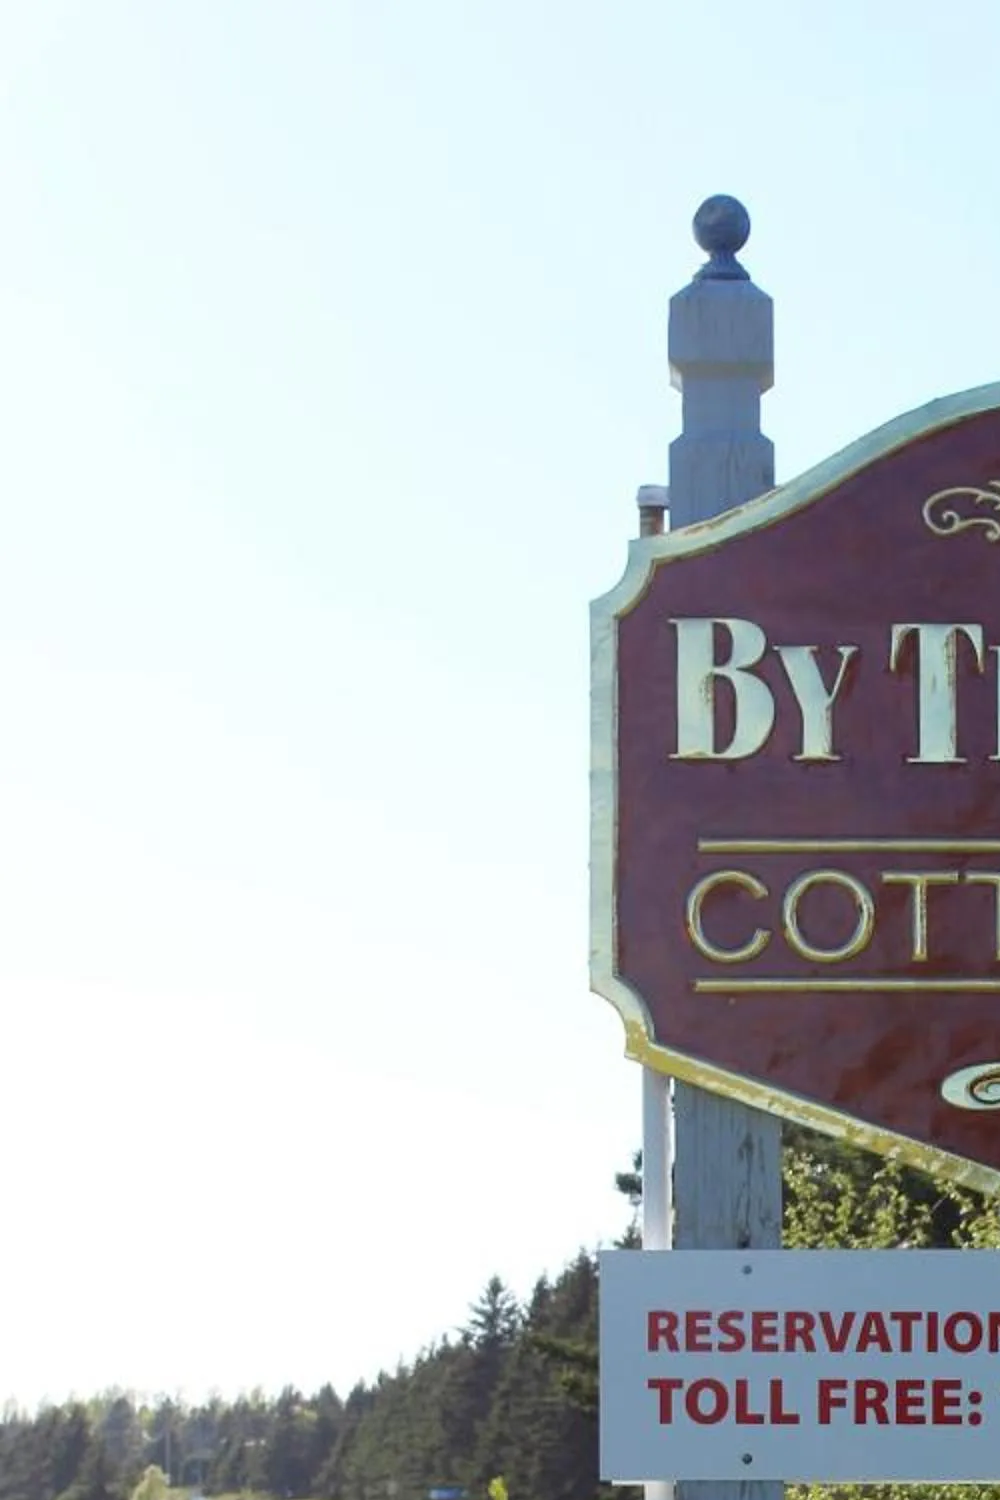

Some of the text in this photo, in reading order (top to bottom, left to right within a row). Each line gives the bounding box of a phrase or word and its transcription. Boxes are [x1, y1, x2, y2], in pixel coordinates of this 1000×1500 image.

[667, 617, 859, 761] BY
[647, 1378, 801, 1425] TOLL
[818, 1378, 983, 1425] FREE:
